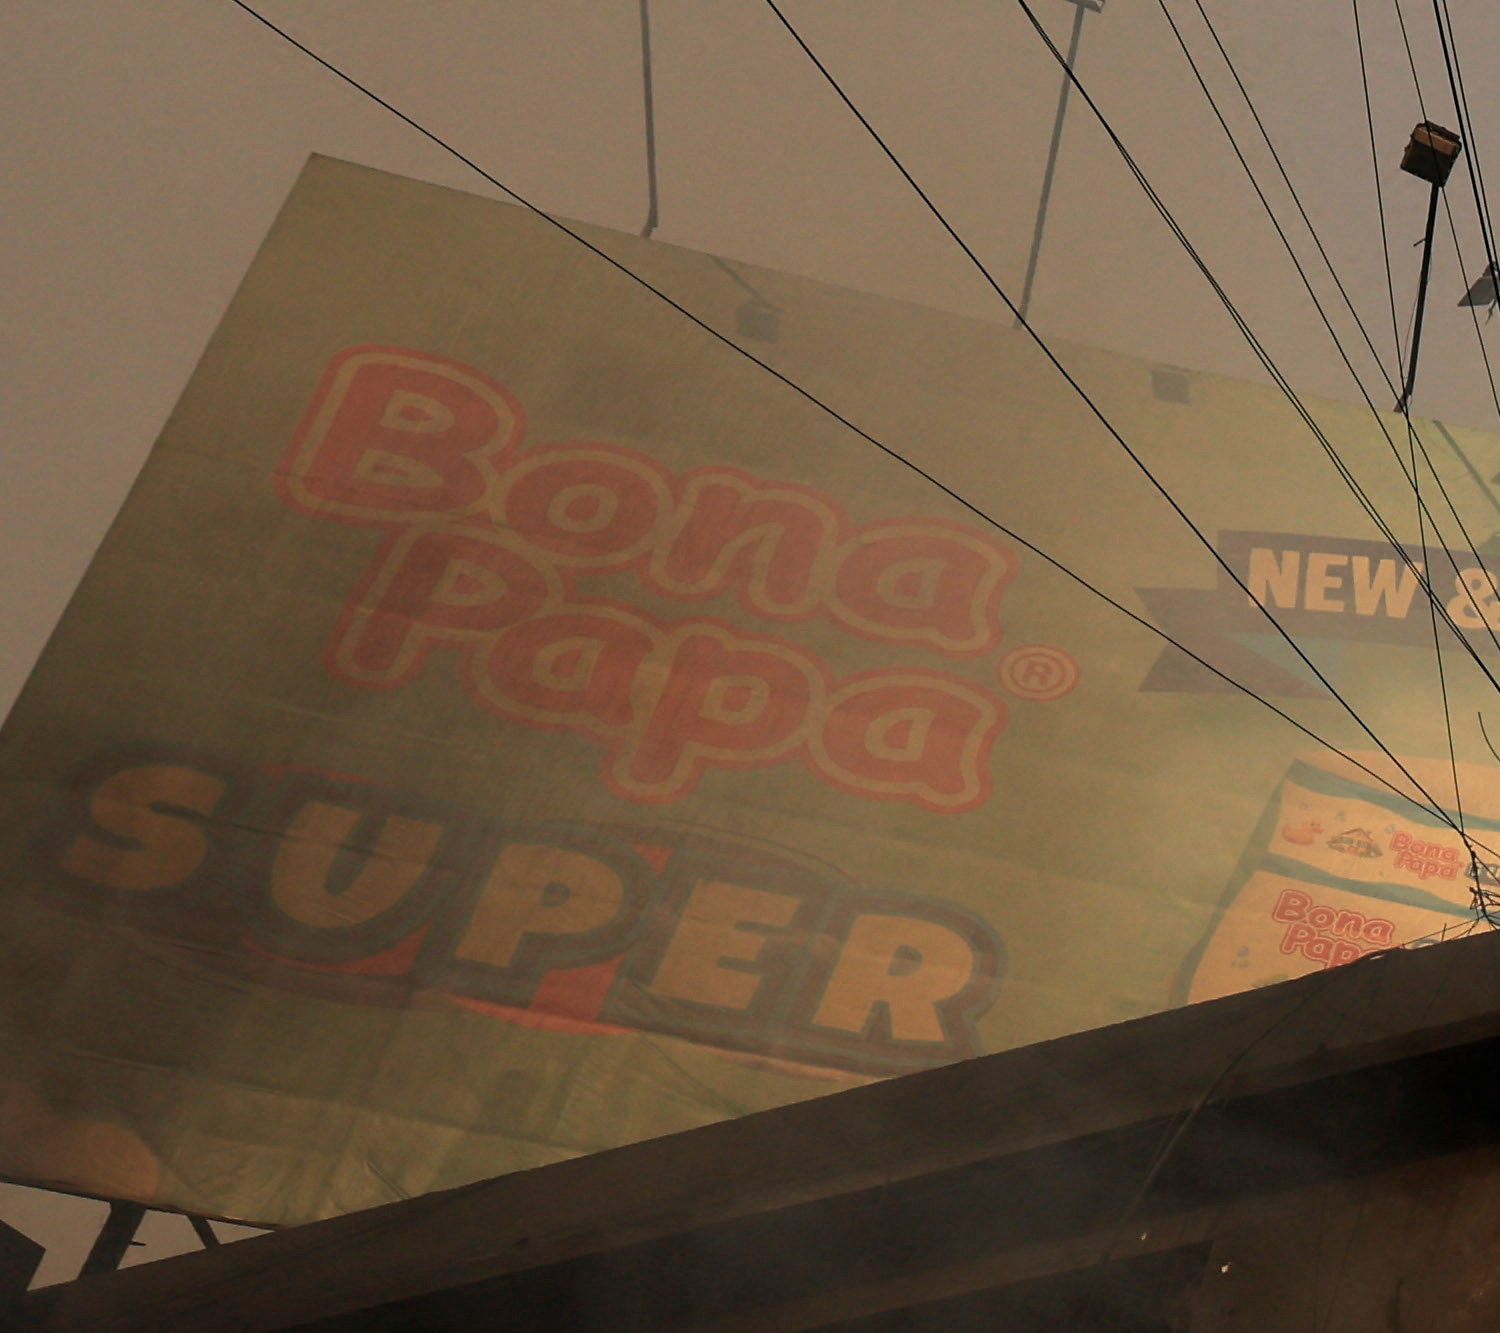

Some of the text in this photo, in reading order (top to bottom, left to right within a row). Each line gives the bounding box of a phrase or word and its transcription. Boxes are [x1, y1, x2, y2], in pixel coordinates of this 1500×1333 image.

[275, 344, 1017, 657] Bona
[1247, 546, 1428, 621] NEW
[320, 524, 1005, 812] Papa
[55, 750, 995, 1055] SUPER
[1272, 888, 1394, 948] Bona
[1280, 921, 1380, 969] Pap
